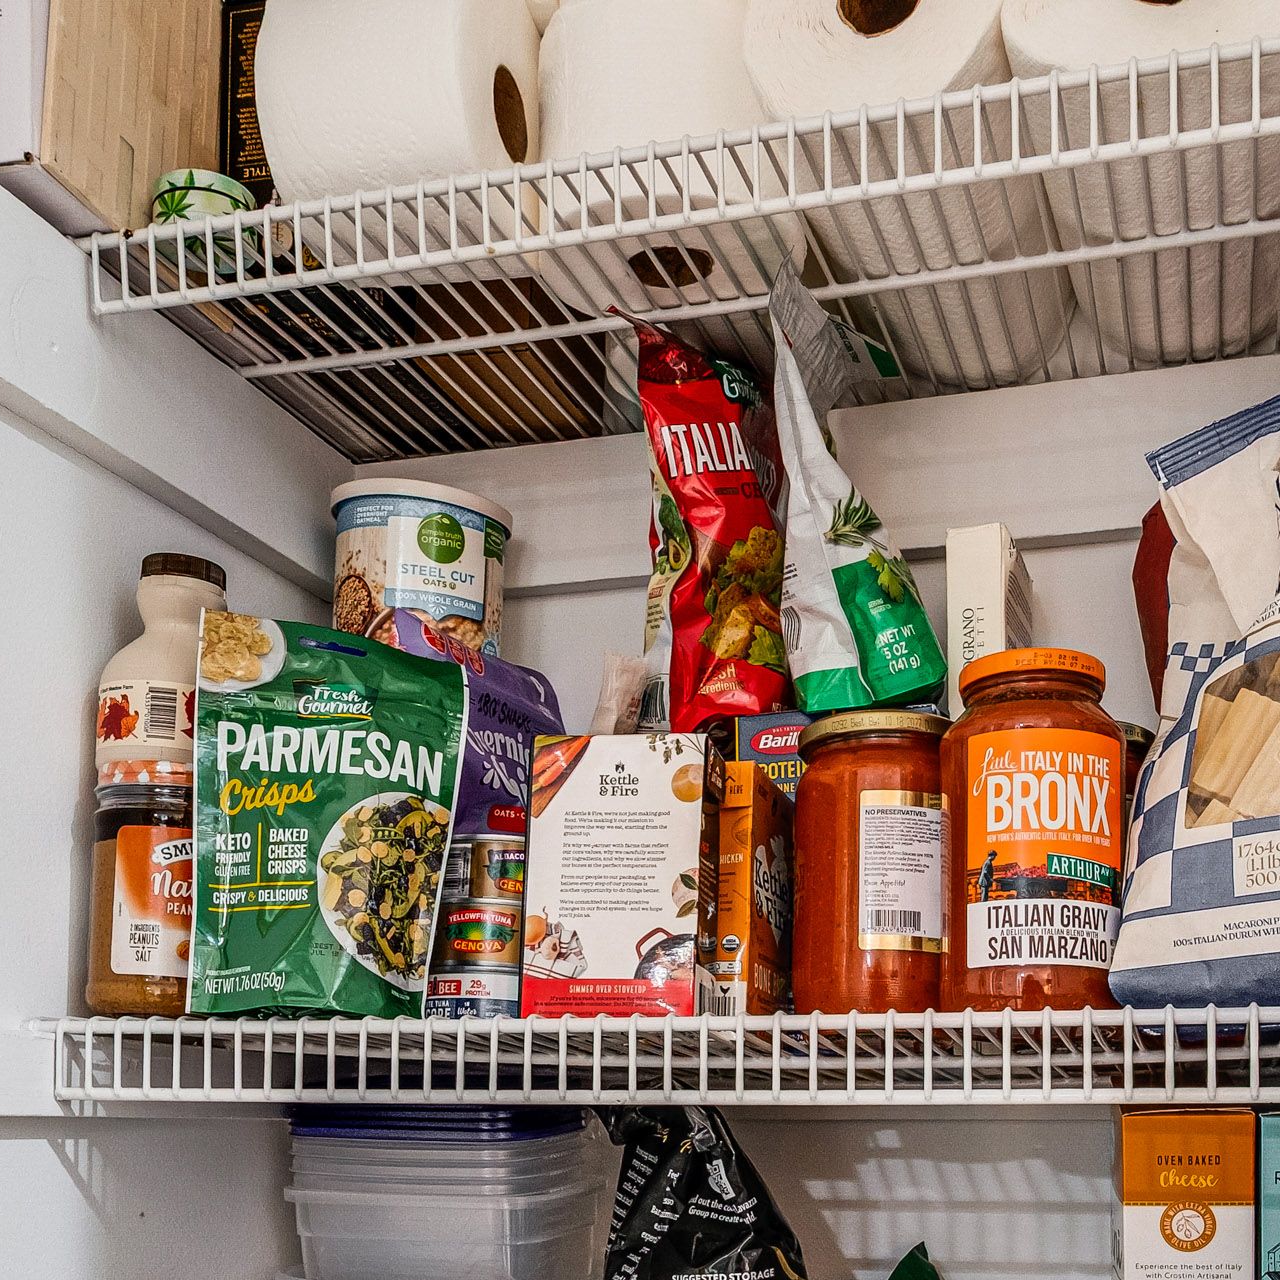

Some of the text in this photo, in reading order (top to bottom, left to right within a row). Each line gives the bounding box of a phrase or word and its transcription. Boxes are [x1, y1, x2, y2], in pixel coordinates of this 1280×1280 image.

[660, 421, 754, 479] ITALIA
[421, 528, 462, 540] simple truth
[421, 535, 462, 550] organic
[401, 564, 475, 586] STEEL CUT
[423, 578, 447, 588] OATS
[420, 593, 451, 605] WHOLE
[453, 599, 476, 611] GRAIN
[311, 685, 362, 702] Fresh
[217, 720, 443, 796] PARMESAN
[1020, 751, 1063, 772] ITALY
[1068, 752, 1084, 774] IN
[1087, 754, 1110, 779] THE
[599, 774, 639, 785] Kettle
[219, 777, 316, 816] Crisps
[599, 786, 638, 796] & Fire
[986, 772, 1110, 836] BRONX
[876, 808, 927, 817] PRESERVATIVES
[216, 833, 251, 851] KETO
[269, 829, 308, 843] BAKED
[216, 851, 251, 864] FRIENDLY
[268, 844, 307, 859] CHEESE
[268, 859, 306, 875] CRISPS
[1051, 857, 1110, 882] ARTHUR AV
[213, 888, 308, 904] CRISPY & DELICIOUS
[448, 912, 512, 925] YELLOWFIN TUNA
[987, 905, 1108, 932] ITALIAN GRAVY
[1223, 917, 1273, 930] MACARONI
[129, 933, 159, 945] PEANUTS
[1006, 928, 1039, 936] DELICIOUS
[1040, 929, 1064, 937] ITALIAN
[1066, 929, 1084, 937] BLEND
[1085, 930, 1098, 939] WITH
[1173, 936, 1193, 947] 100%
[1194, 933, 1228, 946] ITALIAN
[1228, 930, 1261, 943] DURUM
[453, 940, 502, 952] GENOVA
[988, 937, 1107, 963] SAN MARZANO
[135, 950, 151, 962] SALT
[439, 982, 457, 994] BEE
[570, 984, 646, 993] SIMMER OVER STOVETOP
[1157, 1155, 1220, 1166] OVEN BAKED
[1160, 1169, 1219, 1188] Cheese
[1135, 1263, 1178, 1271] Experience
[1225, 1263, 1243, 1271] Italy
